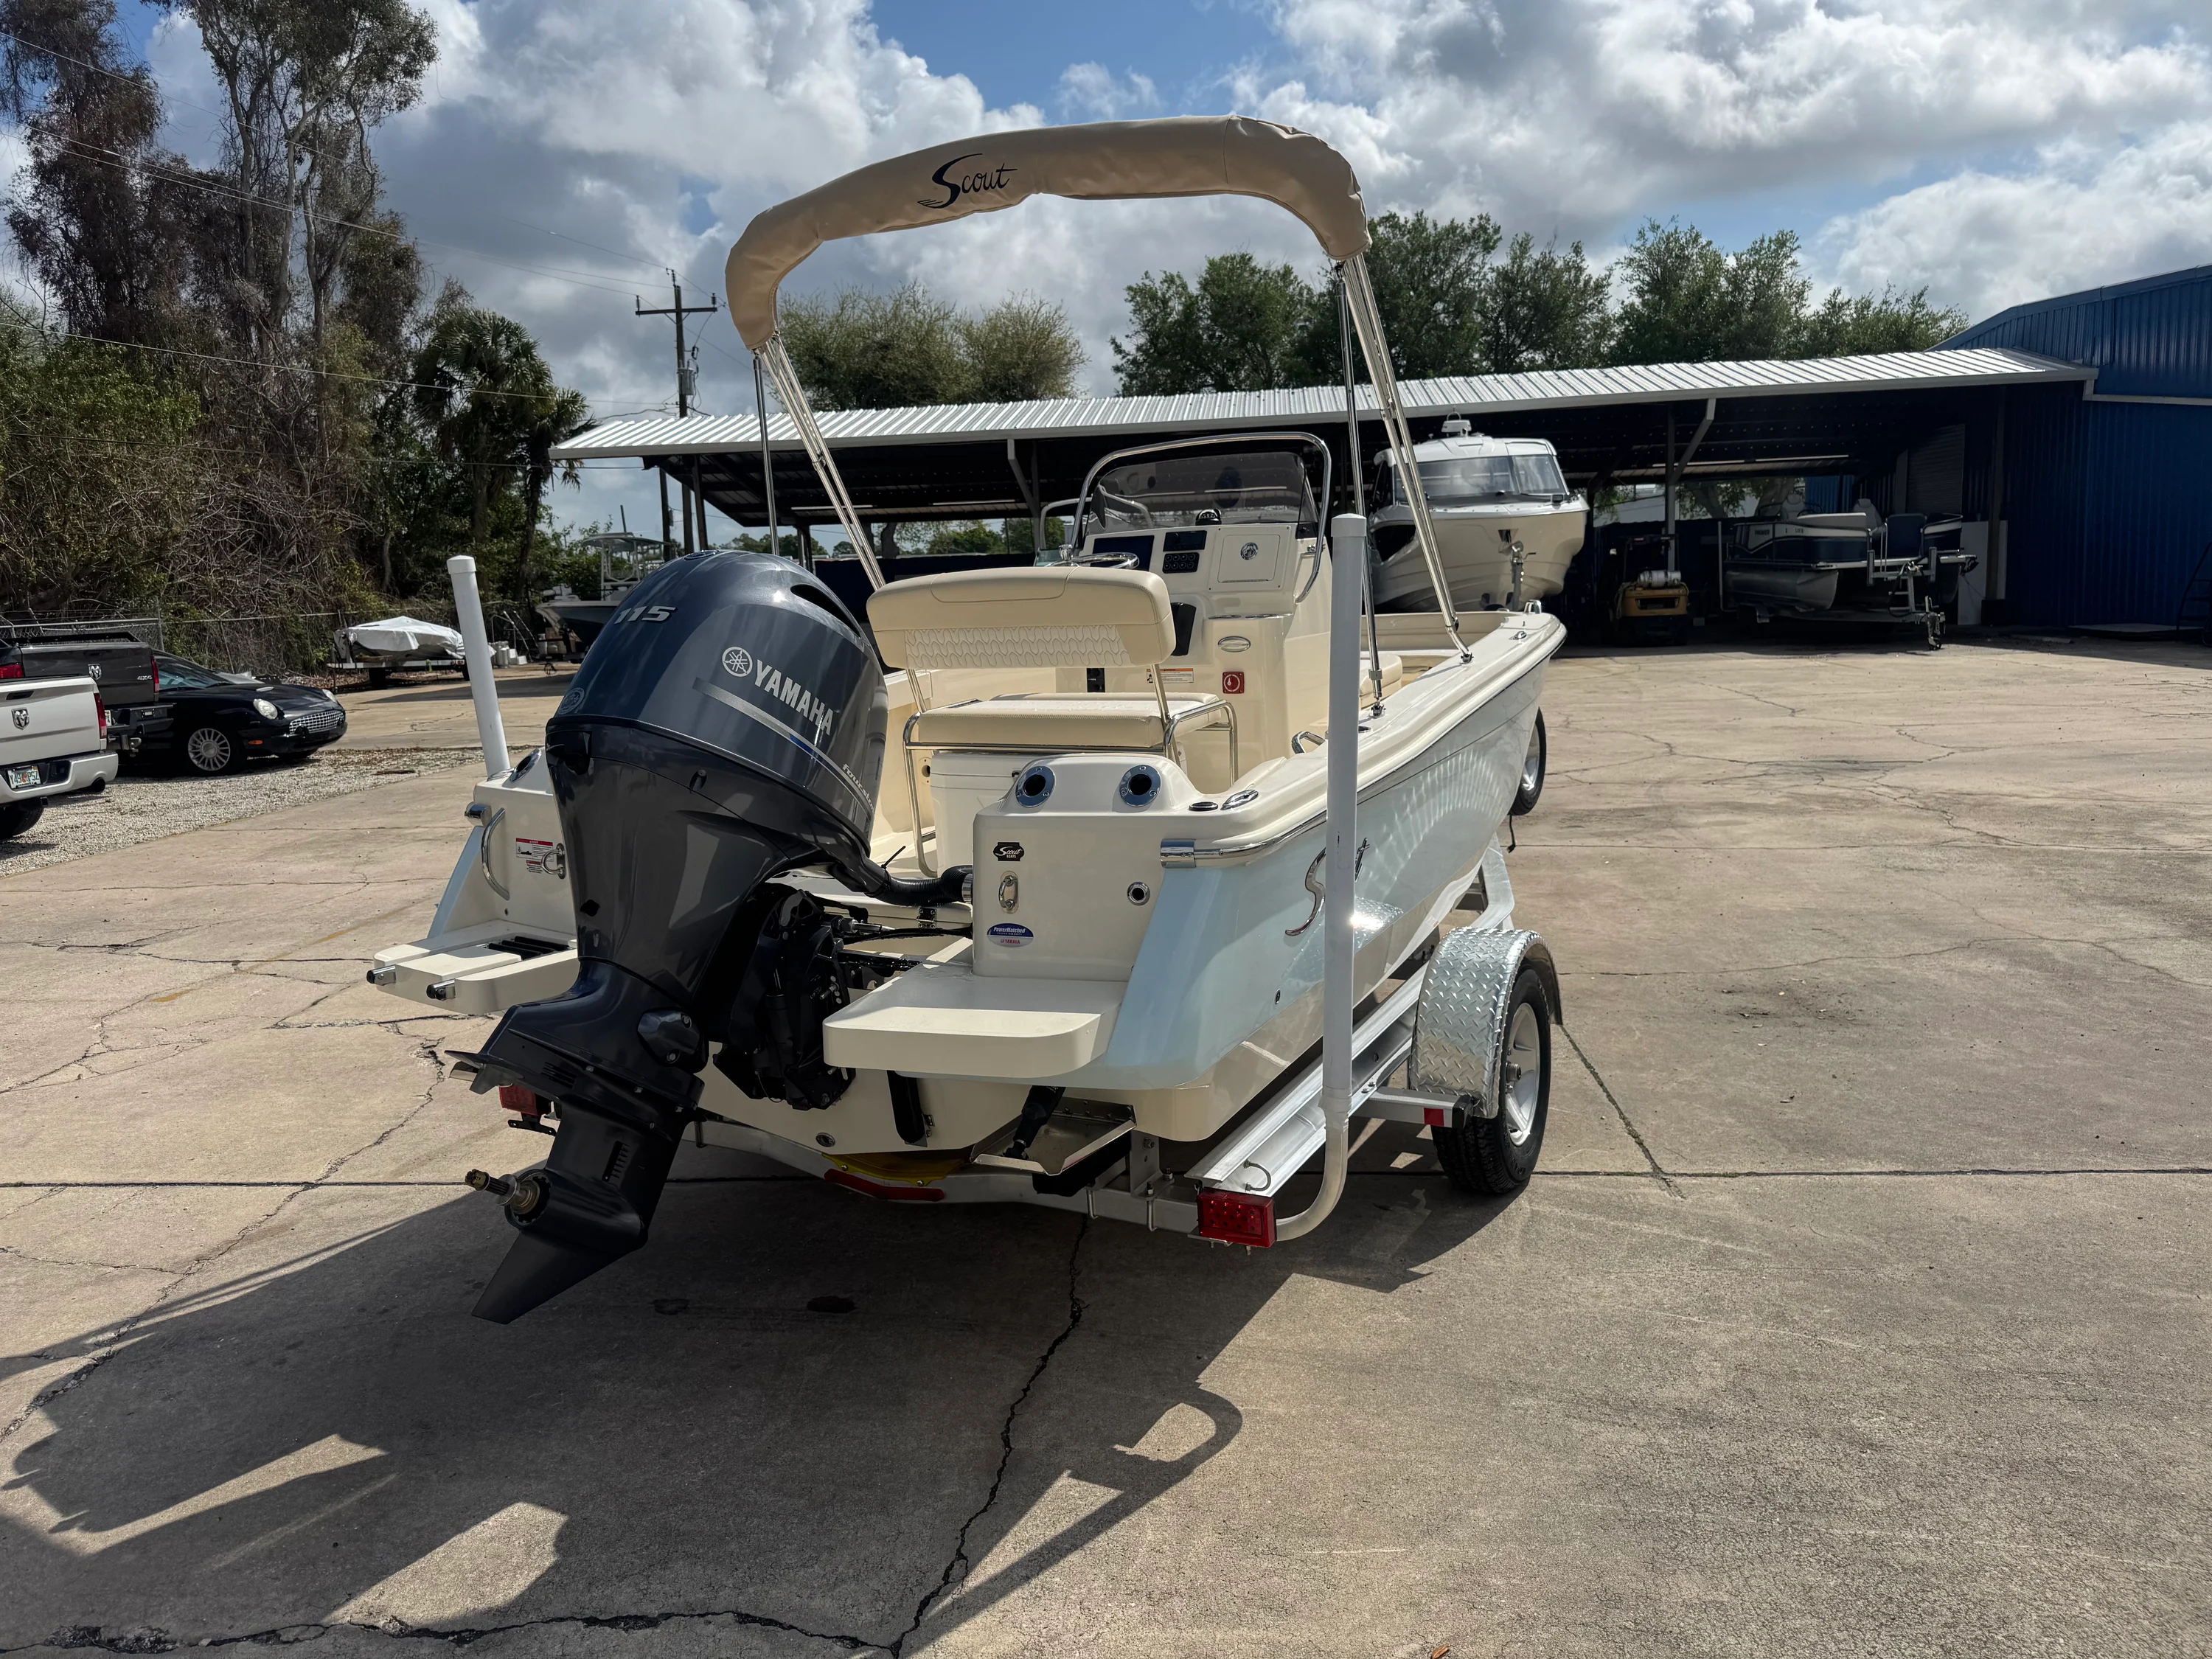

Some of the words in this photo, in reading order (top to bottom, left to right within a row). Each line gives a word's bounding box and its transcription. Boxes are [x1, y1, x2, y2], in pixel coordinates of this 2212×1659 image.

[917, 153, 1018, 209] Scout
[614, 605, 676, 625] 115
[754, 659, 833, 736] YAMAHA
[995, 846, 1023, 856] Scout
